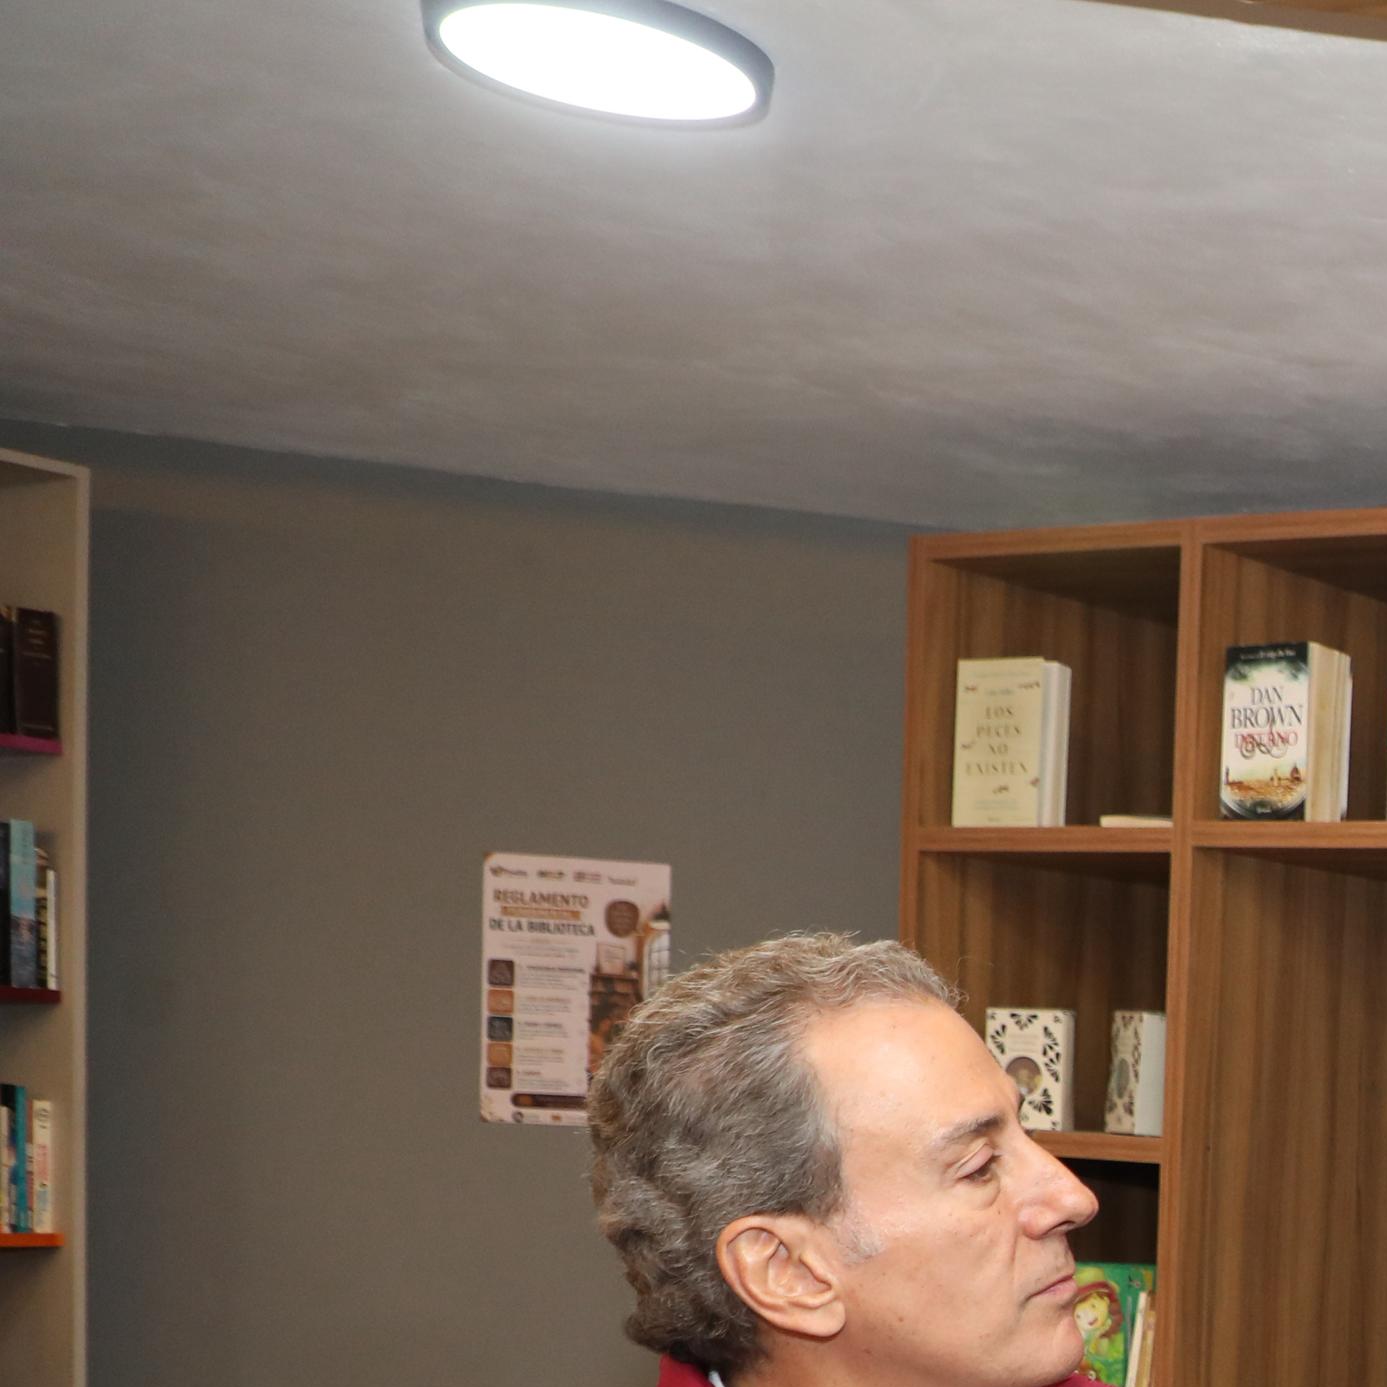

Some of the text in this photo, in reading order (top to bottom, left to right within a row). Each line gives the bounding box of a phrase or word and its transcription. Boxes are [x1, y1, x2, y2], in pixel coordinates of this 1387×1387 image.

[1250, 686, 1284, 705] DAN
[986, 706, 1013, 719] LOS
[1231, 705, 1302, 729] BROWN
[976, 725, 1021, 737] PECES
[988, 743, 1009, 755] NO
[966, 762, 1028, 776] EXISTEN
[493, 888, 589, 908] REGLAMENTO
[489, 917, 595, 937] DE LA BIBLIOTECA
